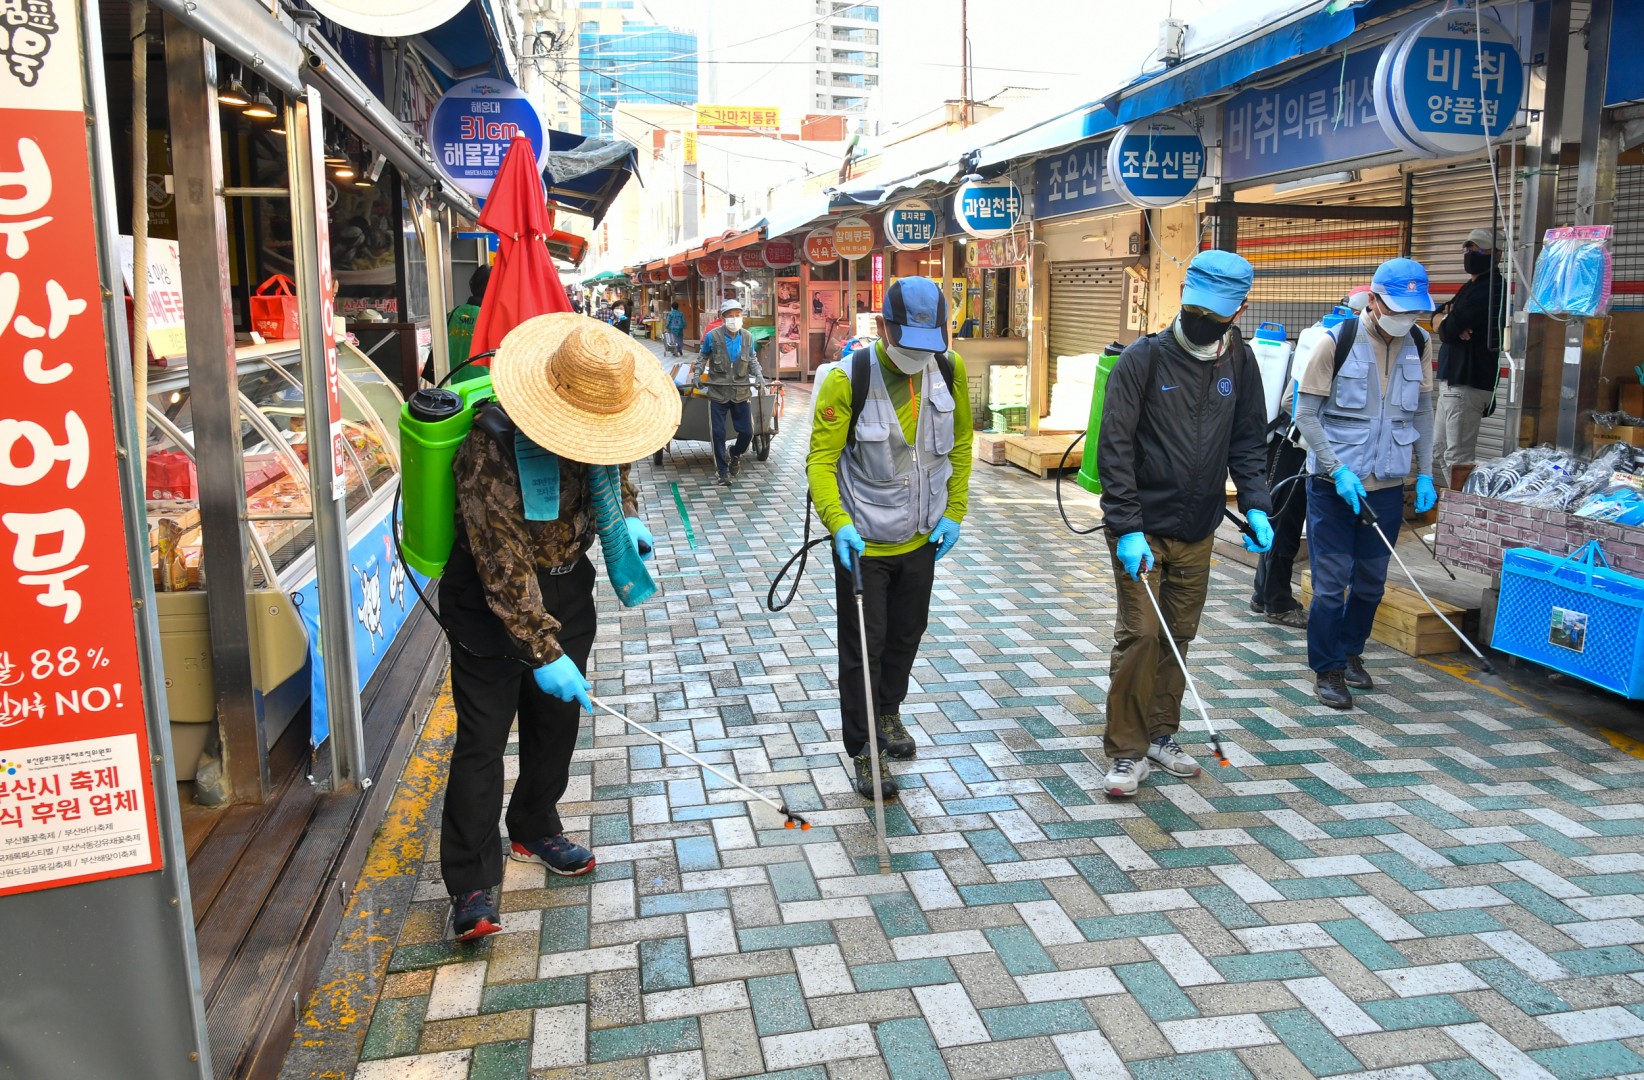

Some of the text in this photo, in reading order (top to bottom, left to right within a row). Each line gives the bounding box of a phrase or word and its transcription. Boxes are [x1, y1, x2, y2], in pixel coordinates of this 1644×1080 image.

[471, 101, 501, 113] 해운대
[714, 110, 777, 125] 가마치통닭
[1427, 95, 1499, 127] 양품점
[460, 115, 519, 140] 31cm
[1122, 151, 1202, 179] 조은신발
[964, 197, 1019, 218] 과일천국
[896, 223, 931, 240] 할매김밥
[1220, 381, 1230, 393] 90
[55, 683, 124, 716] NO!
[70, 766, 119, 791] 축제
[31, 798, 81, 825] 후원
[89, 789, 138, 816] 업체
[5, 831, 55, 846] 부산불꽃축제
[64, 822, 113, 836] 부산바다축제
